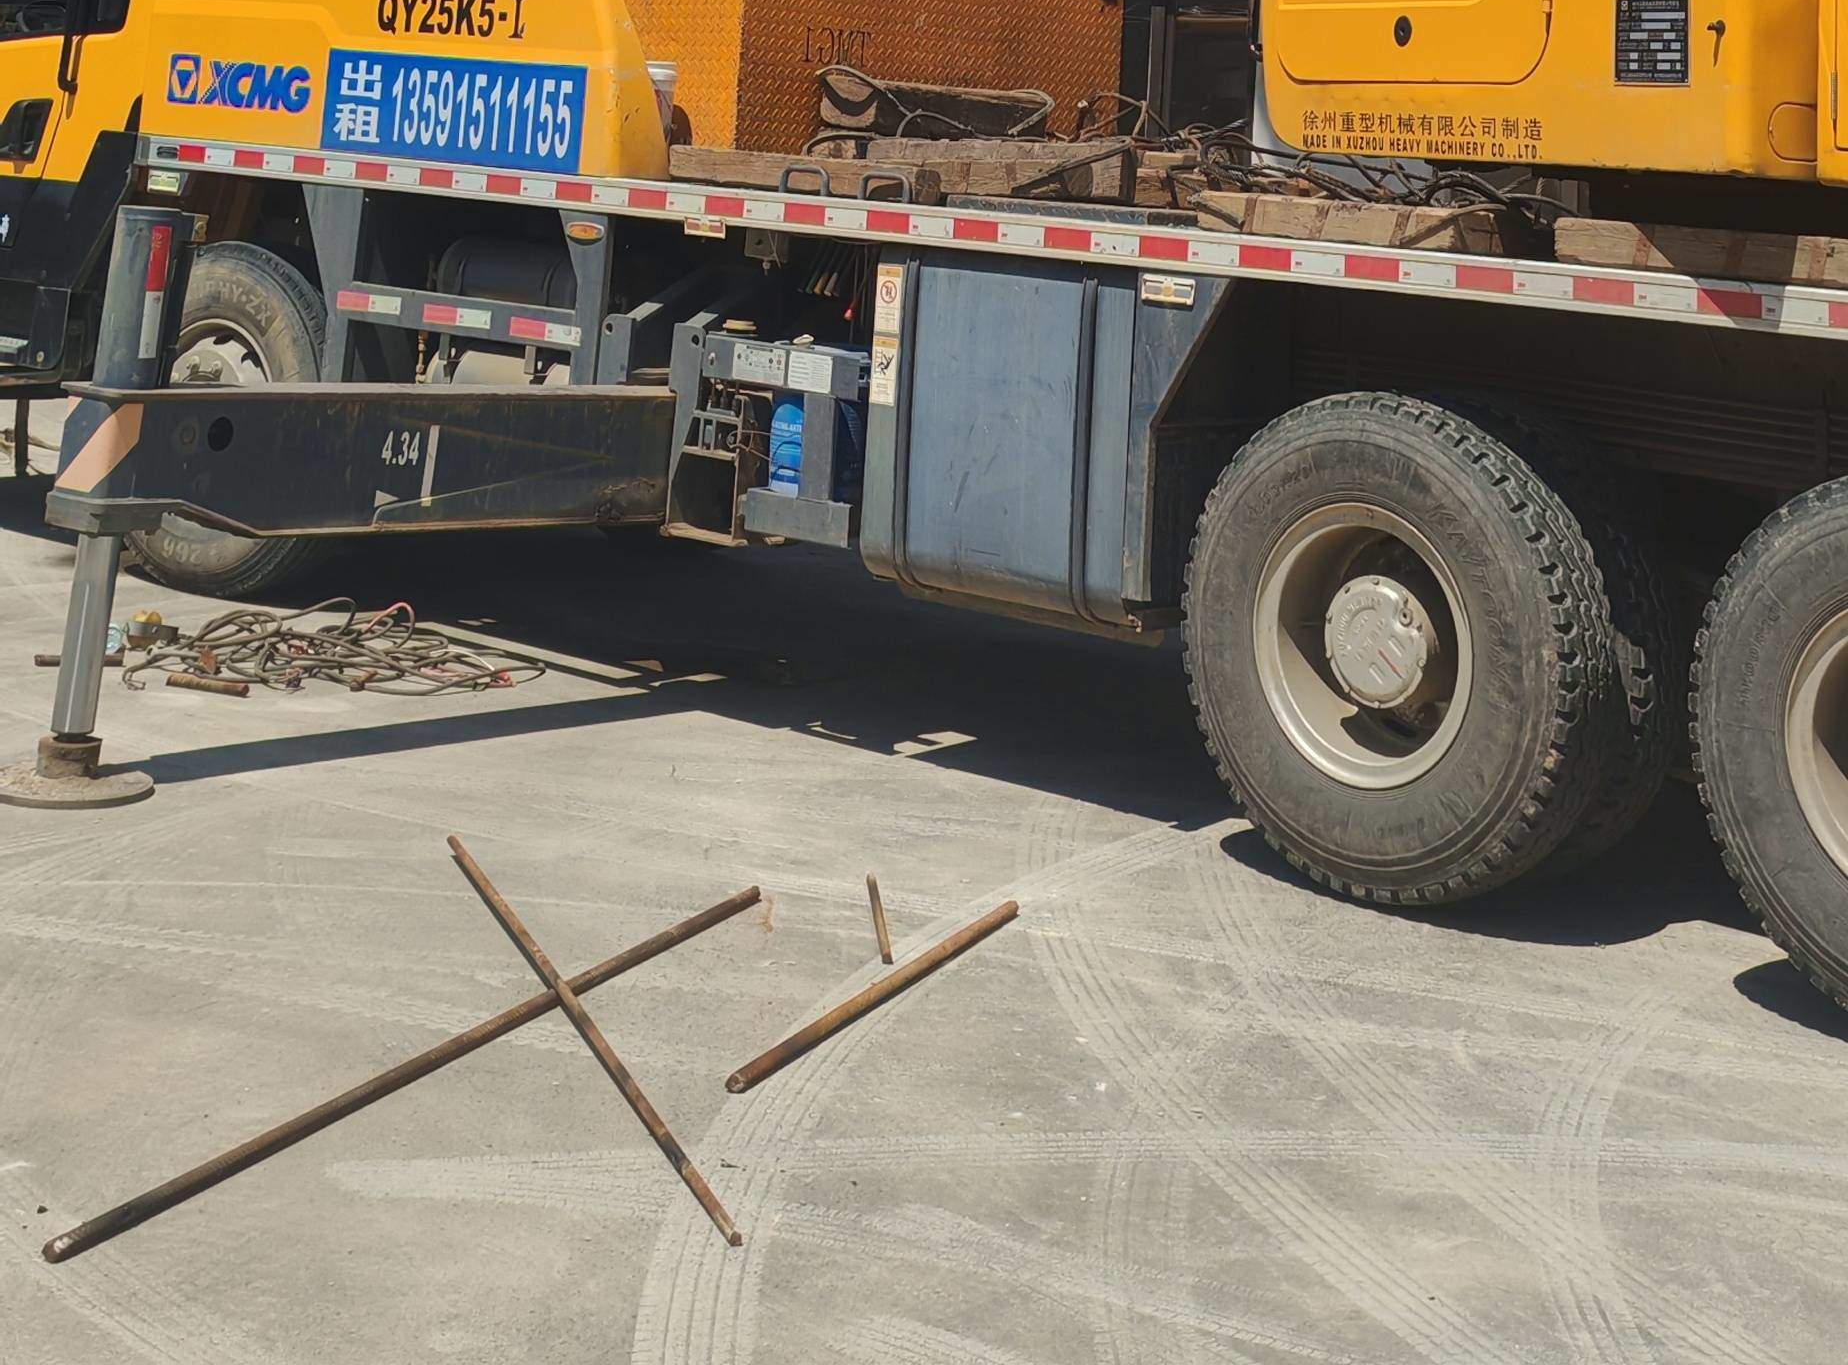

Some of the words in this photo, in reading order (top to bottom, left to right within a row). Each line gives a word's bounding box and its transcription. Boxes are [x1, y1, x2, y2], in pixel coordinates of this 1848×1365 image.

[199, 61, 312, 114] XCMG
[333, 60, 383, 144] 出租
[392, 67, 574, 159] 13591511155
[1302, 110, 1543, 141] 徐州重型机械有限公司制造
[1302, 134, 1327, 149] MADE
[1332, 134, 1342, 149] IN
[1346, 135, 1384, 151] XUZHOU
[1389, 137, 1422, 153] HEAVY
[1426, 139, 1486, 157] MACHINERY
[381, 430, 420, 465] 4.34
